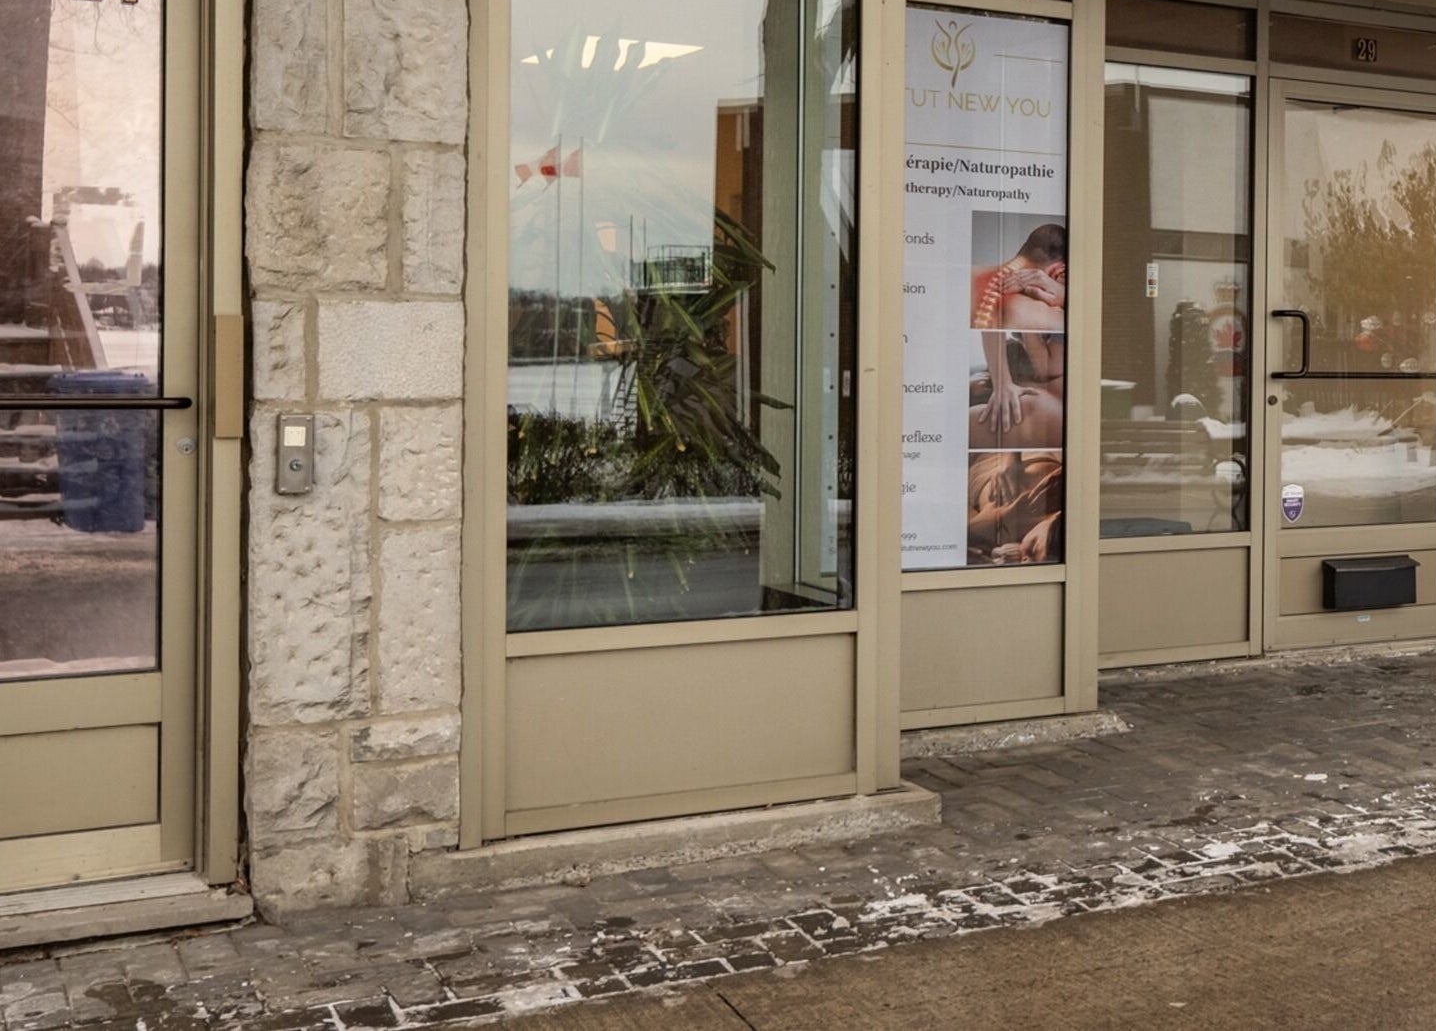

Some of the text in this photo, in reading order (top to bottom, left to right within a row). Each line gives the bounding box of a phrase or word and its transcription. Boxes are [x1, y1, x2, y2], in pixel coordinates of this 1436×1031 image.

[1357, 38, 1376, 61] 29
[947, 91, 1001, 112] NEW
[1005, 96, 1052, 119] YOU
[905, 154, 1055, 179] érapie/Naturopathie
[905, 181, 1032, 202] therapy/Naturopathy
[903, 230, 935, 245] onds
